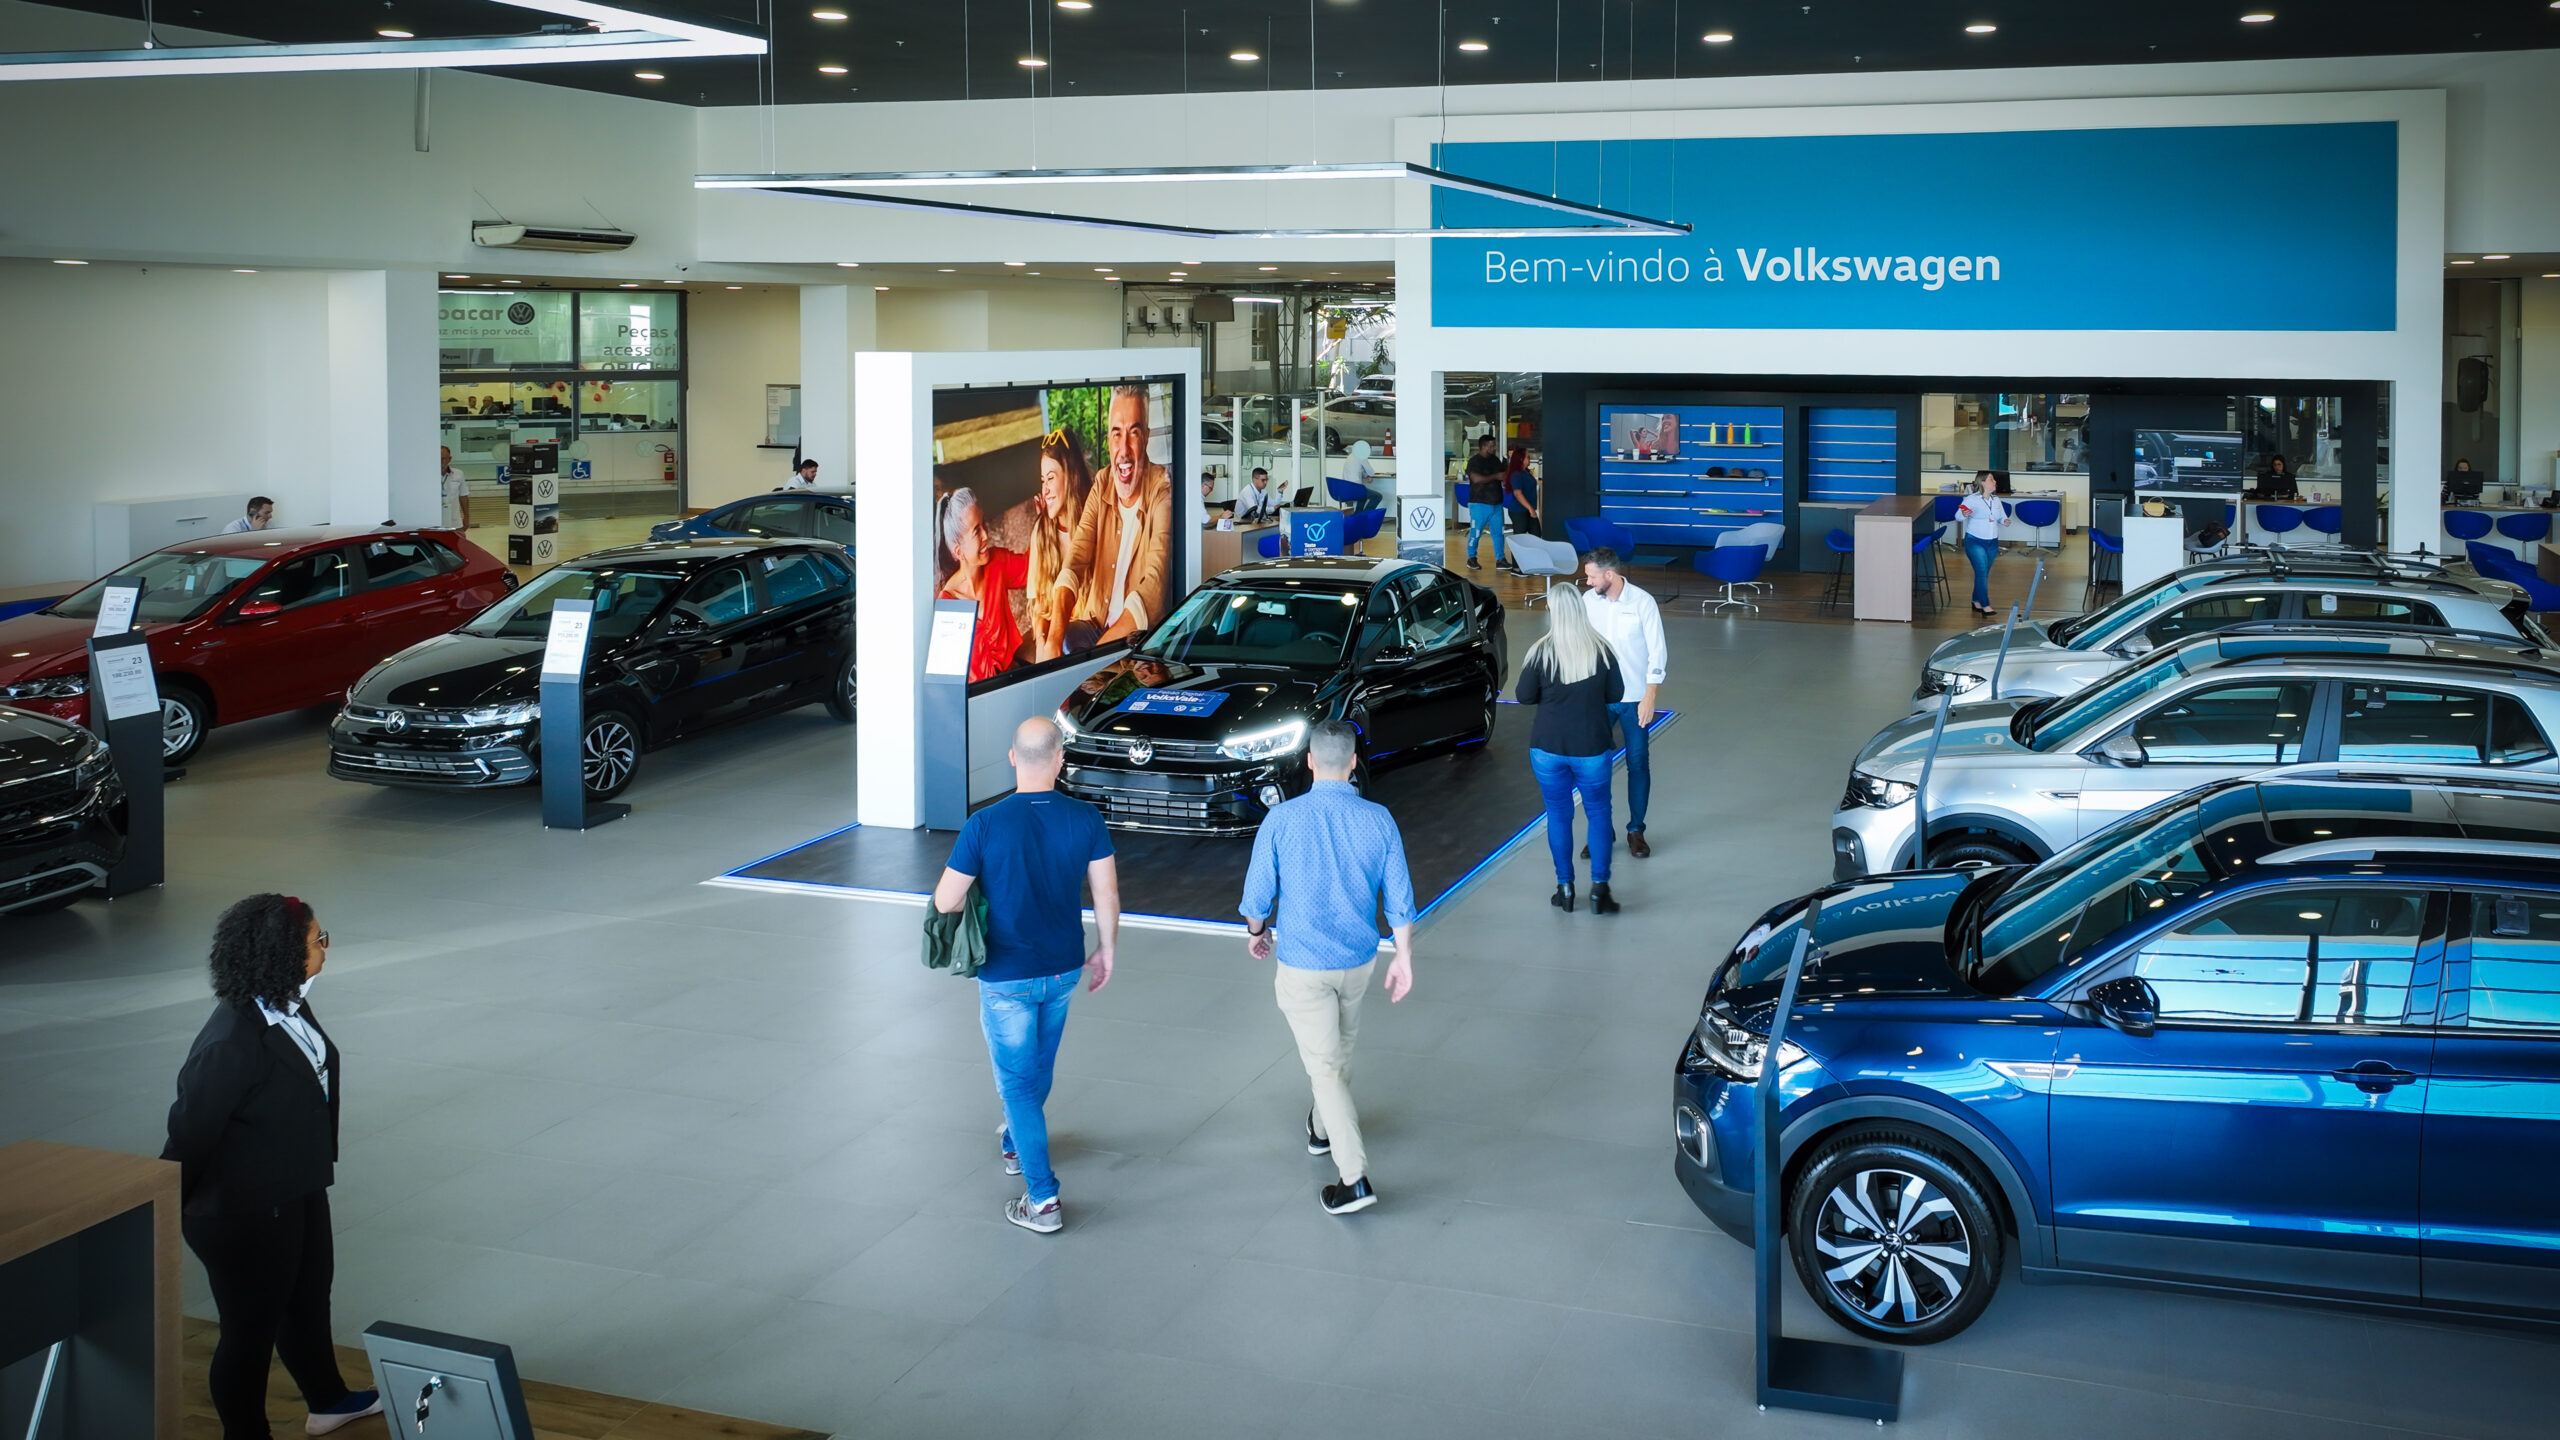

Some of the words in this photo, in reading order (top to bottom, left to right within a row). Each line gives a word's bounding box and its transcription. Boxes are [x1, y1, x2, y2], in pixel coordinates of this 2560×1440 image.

[1486, 248, 1690, 284] Bem-vindo
[1703, 247, 1725, 282] à
[1736, 246, 2000, 291] Volkswagen
[482, 328, 501, 337] por
[504, 327, 533, 336] você.
[618, 324, 669, 341] Peças
[132, 656, 143, 665] 23
